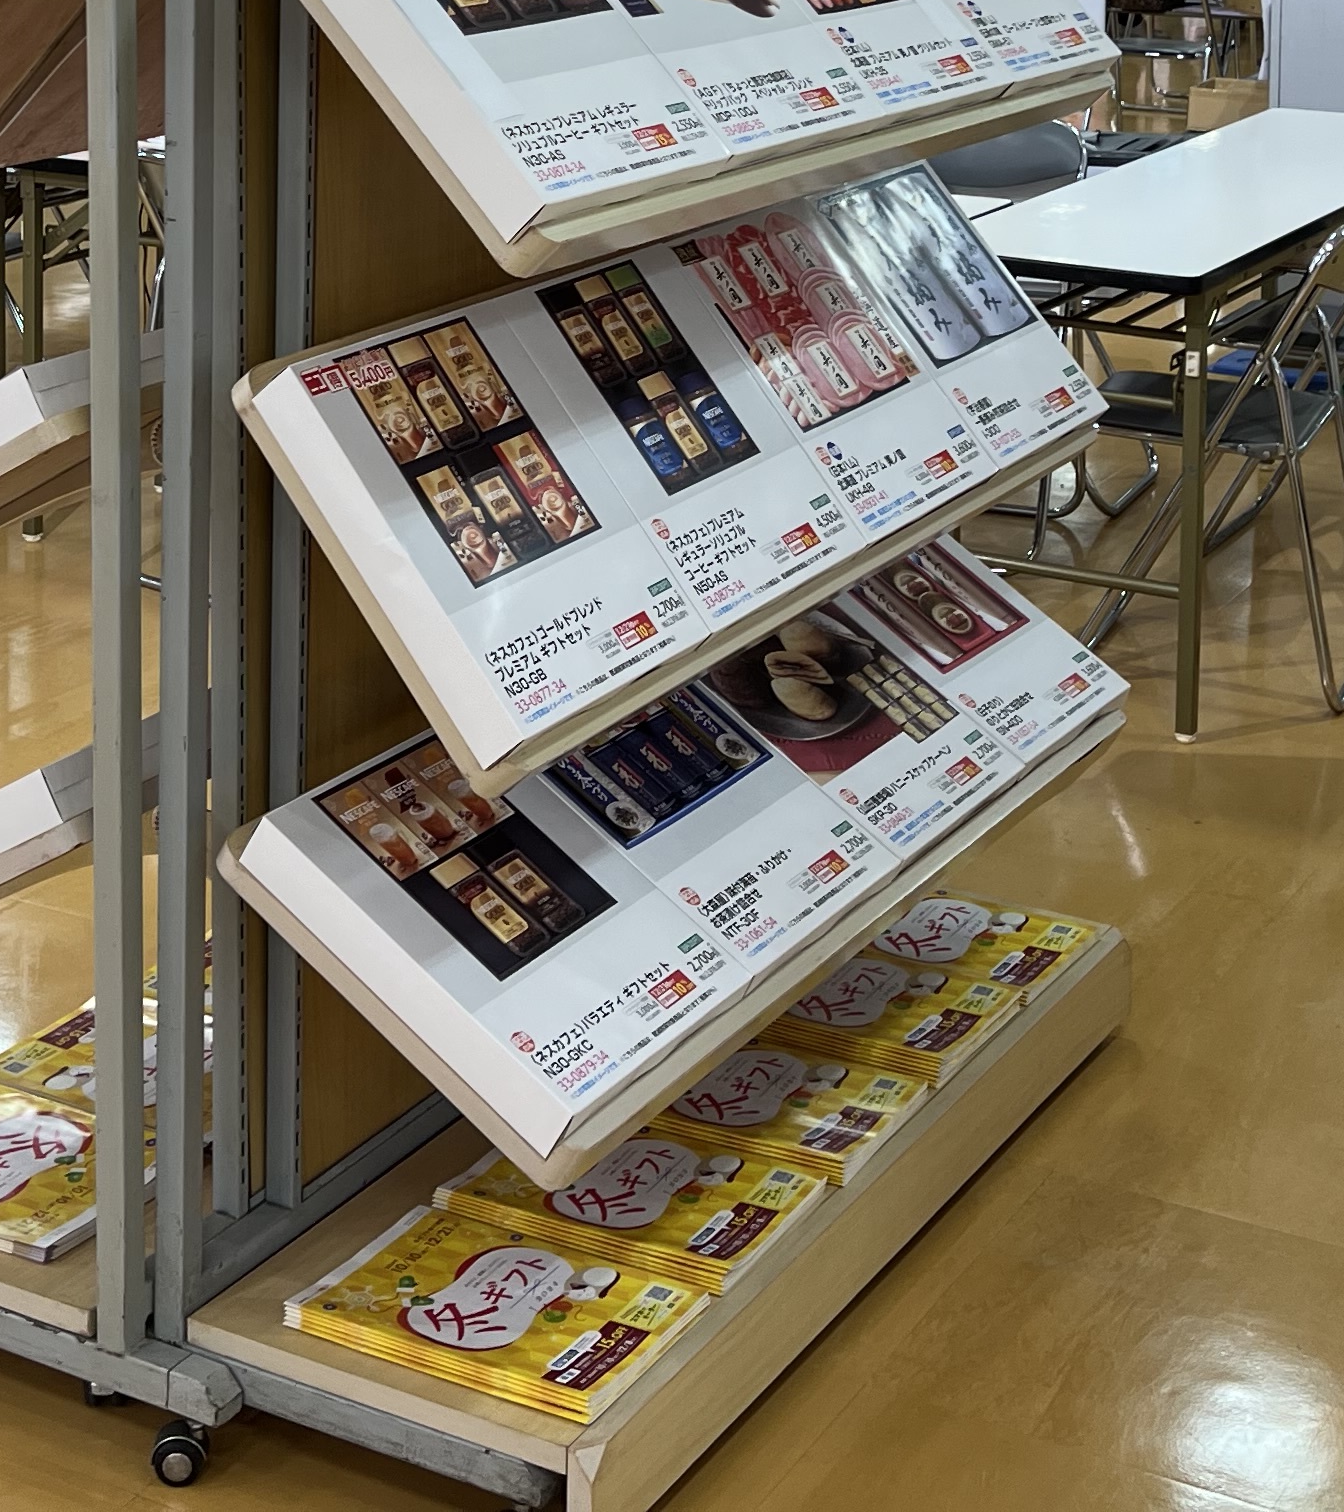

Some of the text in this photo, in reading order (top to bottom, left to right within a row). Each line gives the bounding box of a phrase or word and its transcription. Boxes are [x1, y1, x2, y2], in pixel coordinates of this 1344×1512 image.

[693, 571, 730, 596] N50-AS
[504, 668, 549, 698] N30-GB
[543, 1038, 595, 1080] N30-GKC
[568, 1147, 676, 1225] 冬ギフト
[426, 1255, 548, 1340] 冬ギフト
